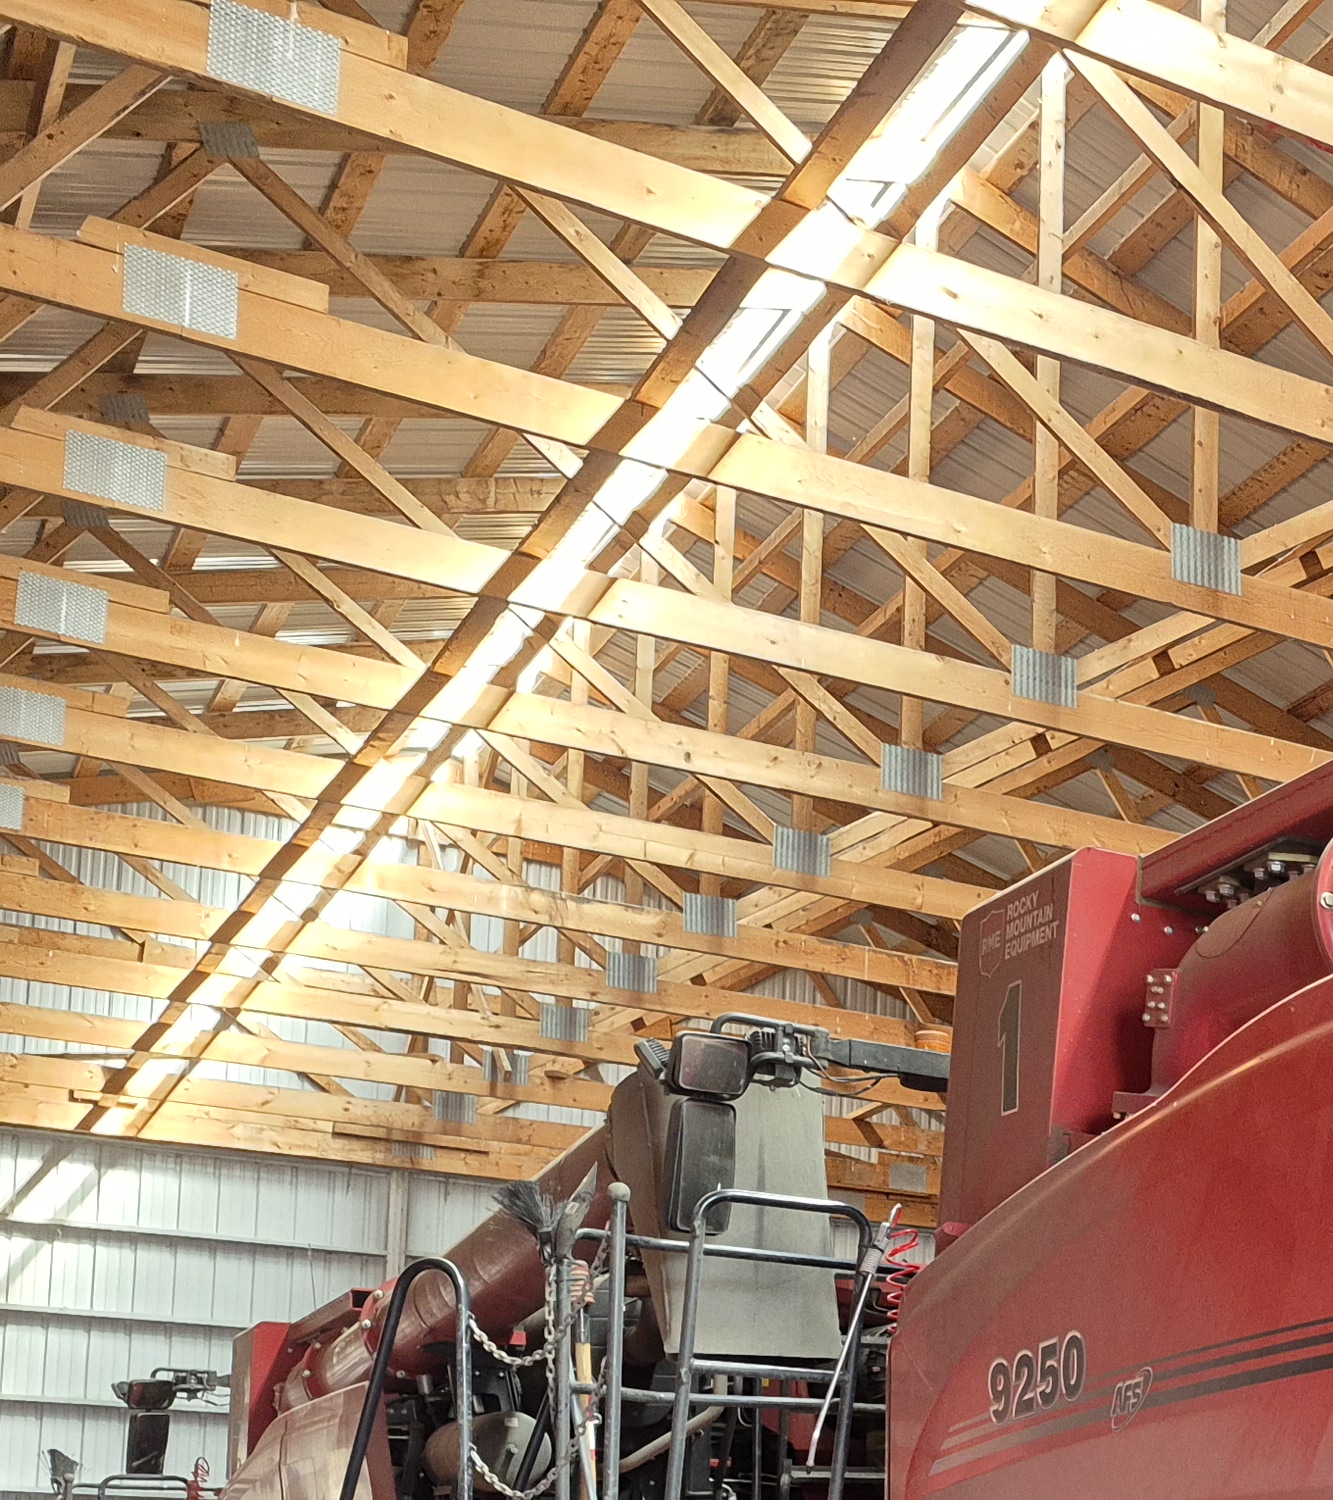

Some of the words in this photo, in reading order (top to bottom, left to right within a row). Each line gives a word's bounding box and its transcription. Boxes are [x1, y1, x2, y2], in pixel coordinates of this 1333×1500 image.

[1005, 905, 1054, 941] MOUNTAIN
[1006, 890, 1039, 919] ROCKY
[982, 930, 1001, 956] RME
[1003, 920, 1060, 961] EQUIPMENT
[998, 978, 1022, 1118] 1
[987, 1329, 1087, 1425] 9250
[1110, 1375, 1146, 1418] AFS
